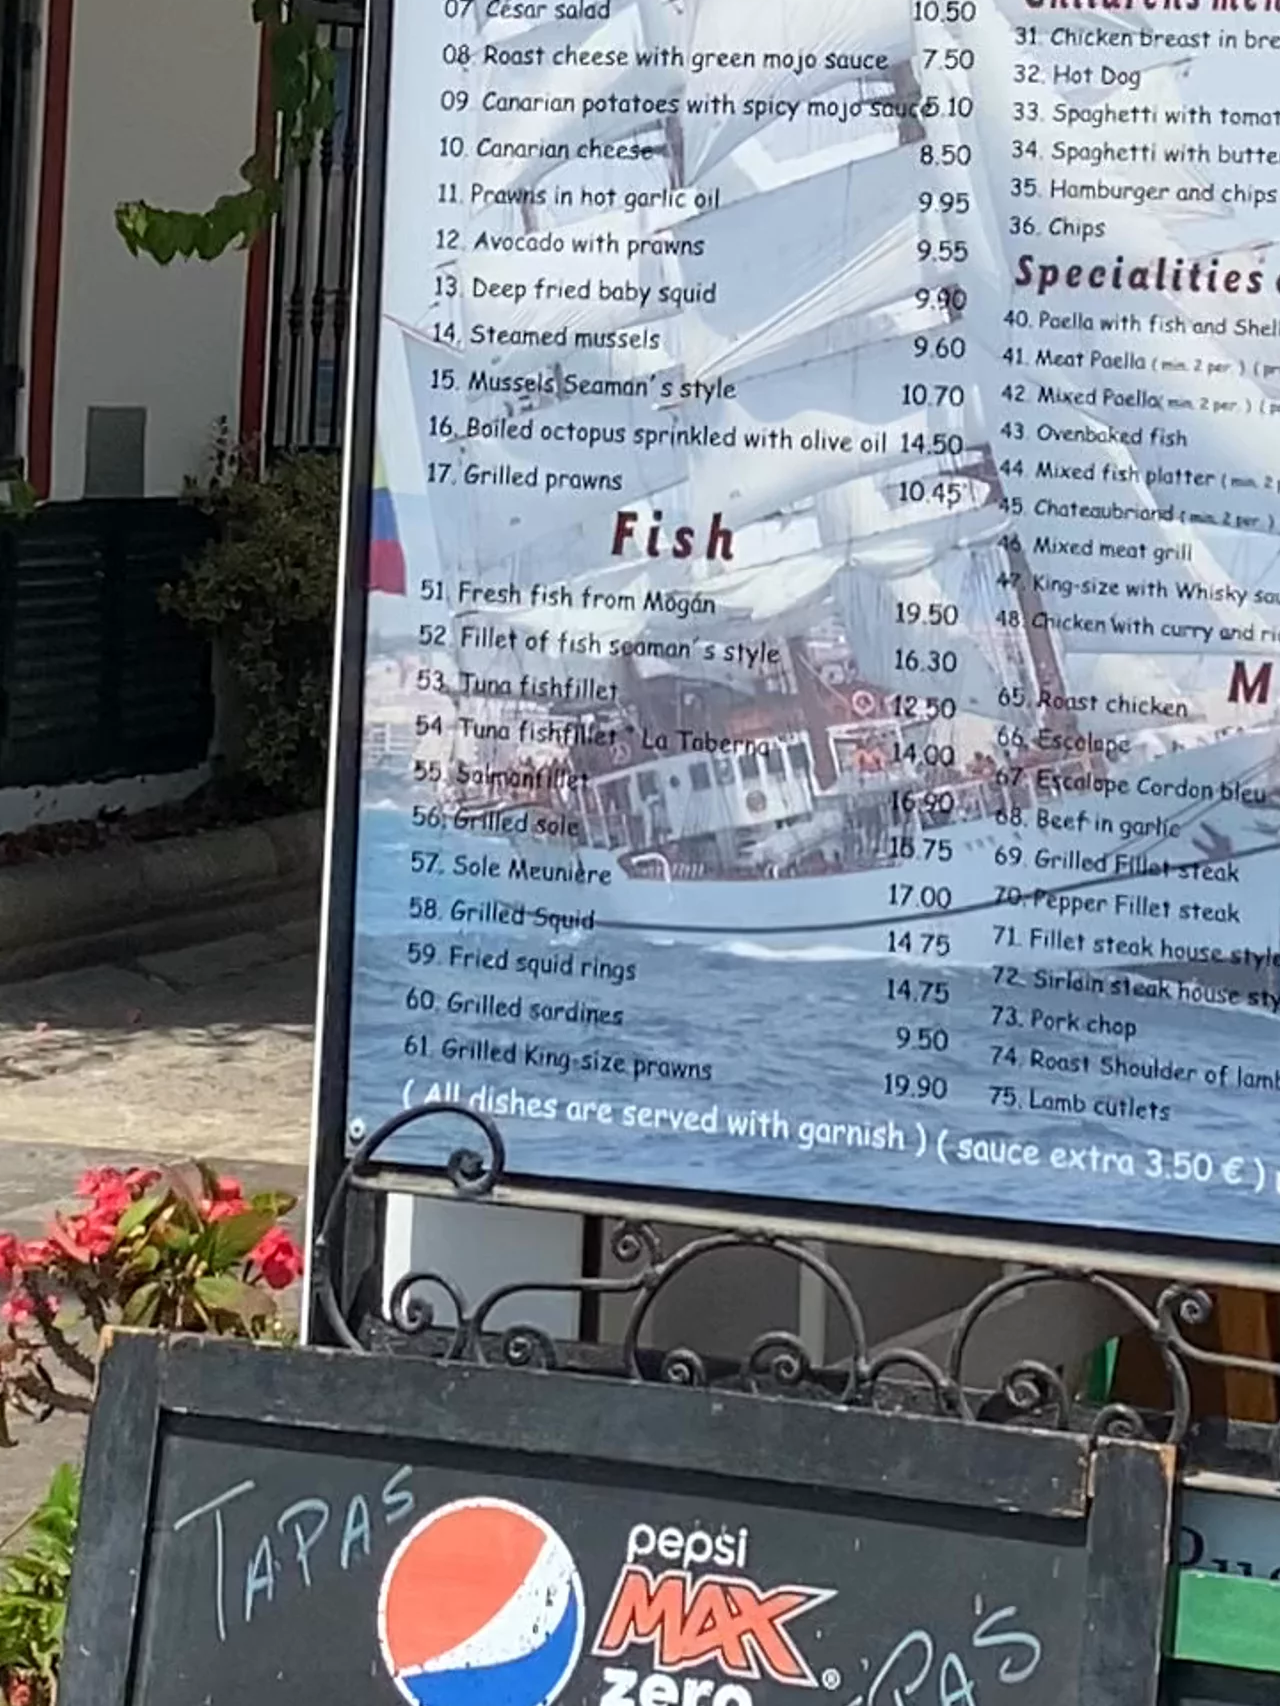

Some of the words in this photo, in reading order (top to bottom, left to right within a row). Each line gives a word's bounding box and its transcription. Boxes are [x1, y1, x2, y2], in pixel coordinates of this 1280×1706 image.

[1052, 65, 1095, 86] Hot
[1101, 67, 1142, 90] Dog
[1050, 180, 1169, 204] Hamburger
[1175, 183, 1214, 202] and
[1221, 184, 1278, 207] chips
[473, 231, 565, 254] Avocado
[571, 233, 619, 255] with
[625, 236, 705, 259] prawns
[916, 239, 969, 263] 9.55
[1014, 255, 1264, 296] Specialities
[611, 508, 735, 561] Fish
[1028, 1088, 1084, 1117] Lamb
[1093, 1094, 1172, 1124] cutlets
[957, 1135, 1041, 1168] sauce
[1049, 1145, 1136, 1177] extra
[1145, 1148, 1214, 1185] 3.50
[174, 1465, 414, 1642] TAPAS
[625, 1522, 749, 1569] pepsi
[591, 1564, 839, 1688] MAX
